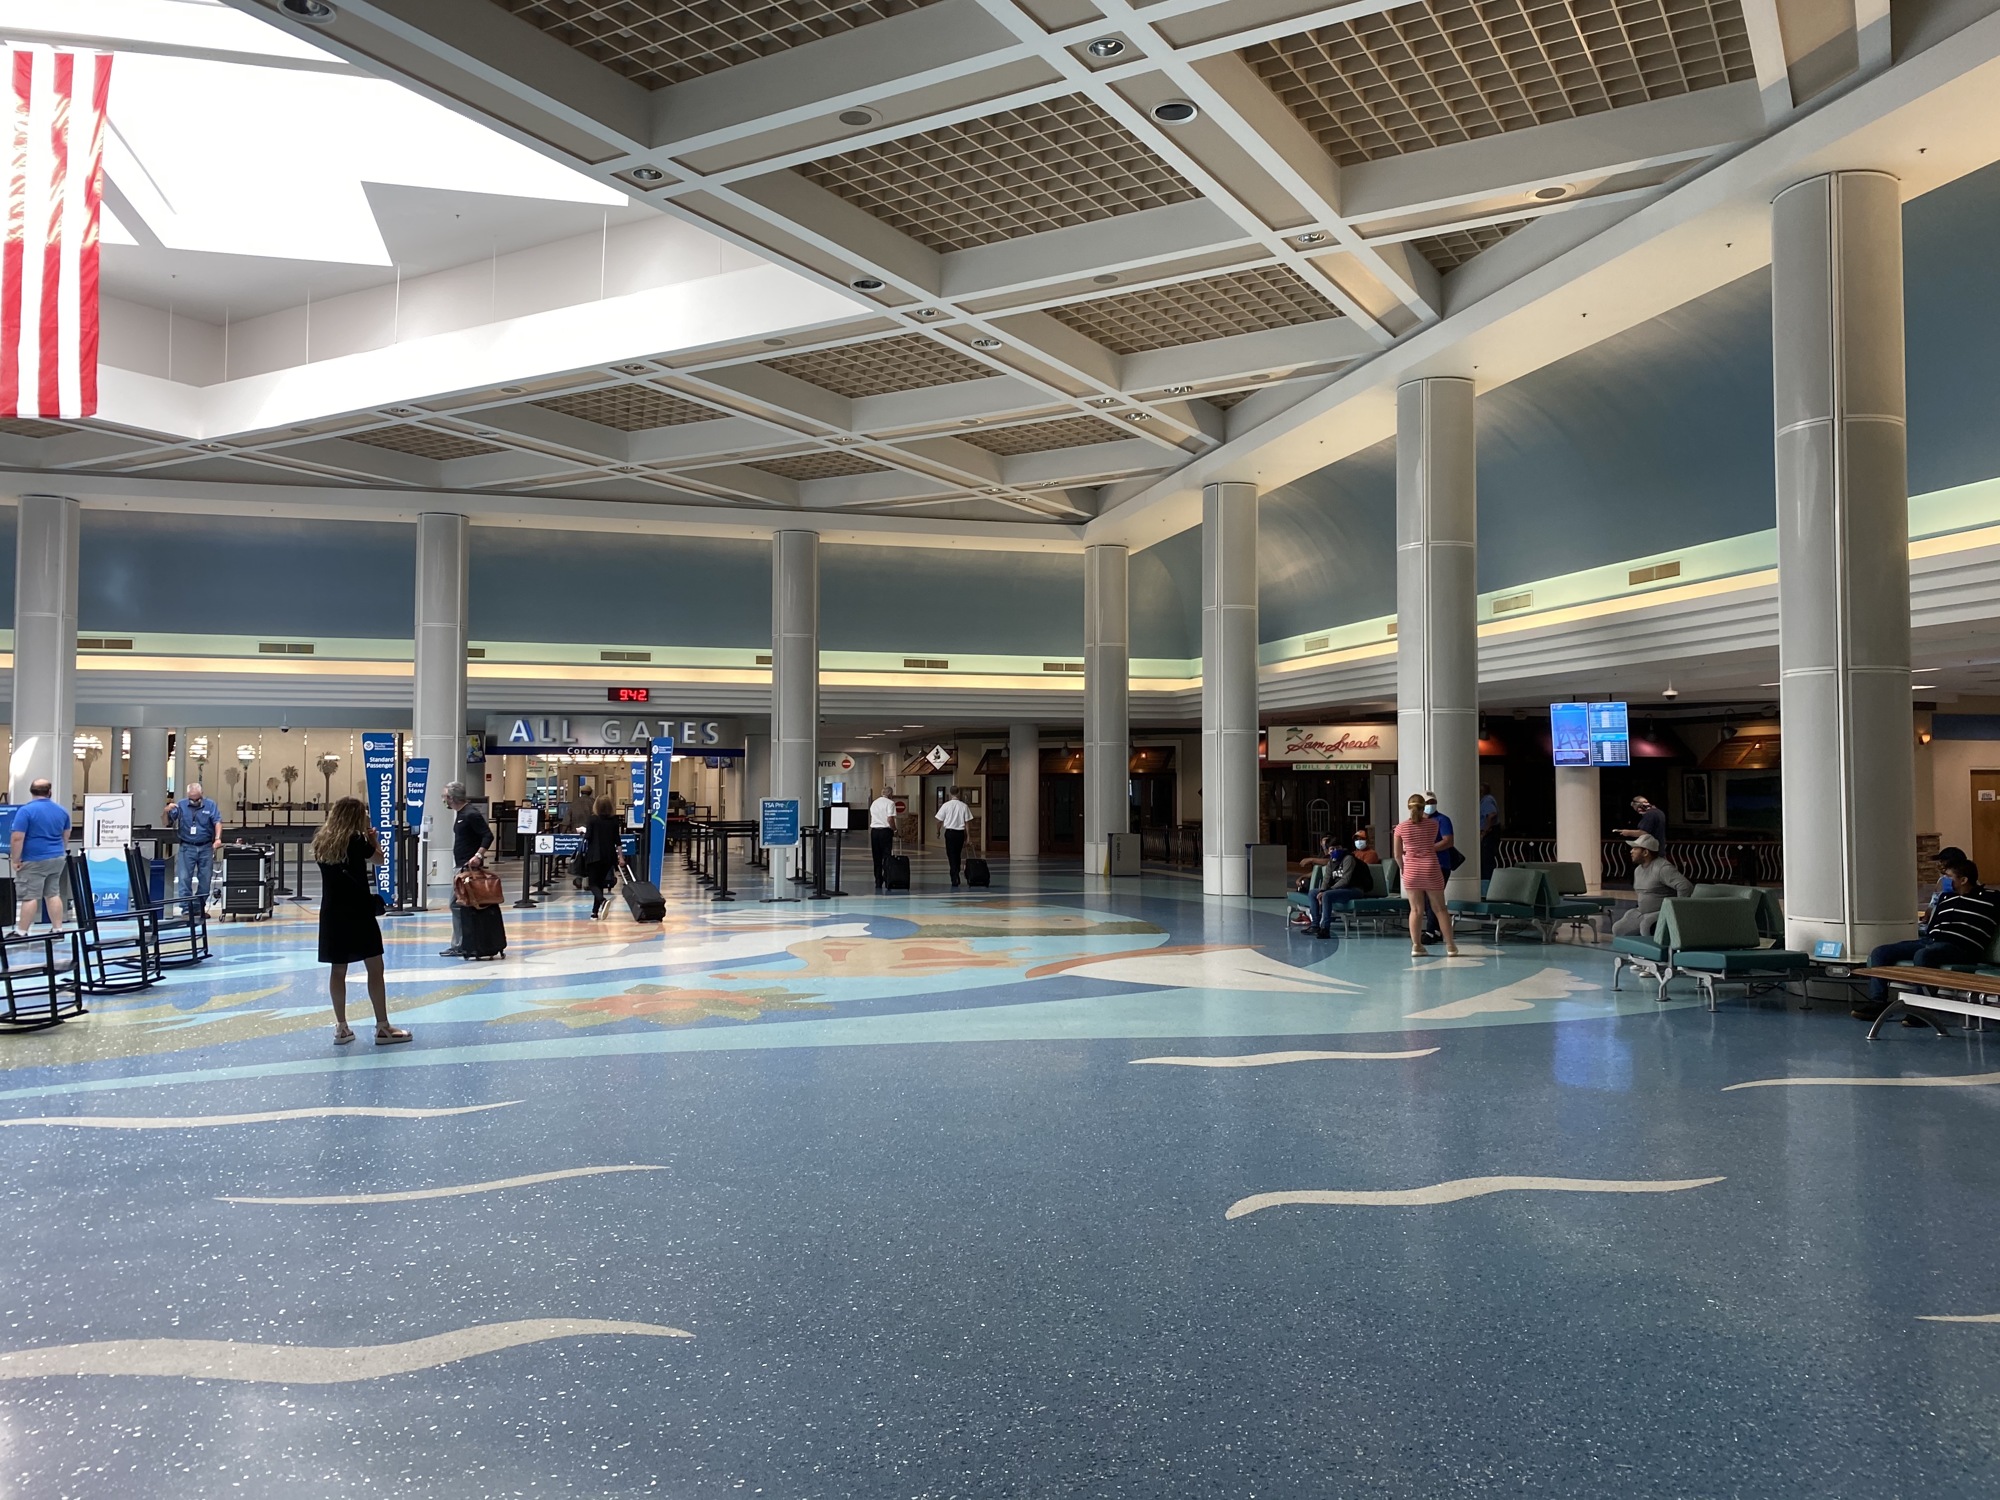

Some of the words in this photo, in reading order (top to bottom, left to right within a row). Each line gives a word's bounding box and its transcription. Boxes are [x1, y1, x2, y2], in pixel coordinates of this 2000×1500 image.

[509, 720, 577, 743] ALL
[601, 720, 719, 744] GATES
[567, 747, 629, 755] Concourses
[634, 747, 641, 755] A
[1285, 733, 1325, 755] Sam
[653, 760, 663, 786] TSA
[818, 760, 836, 768] NTER
[380, 773, 392, 828] Standard
[652, 788, 663, 810] Pre
[379, 831, 392, 893] Passenger
[102, 892, 120, 900] JAX
